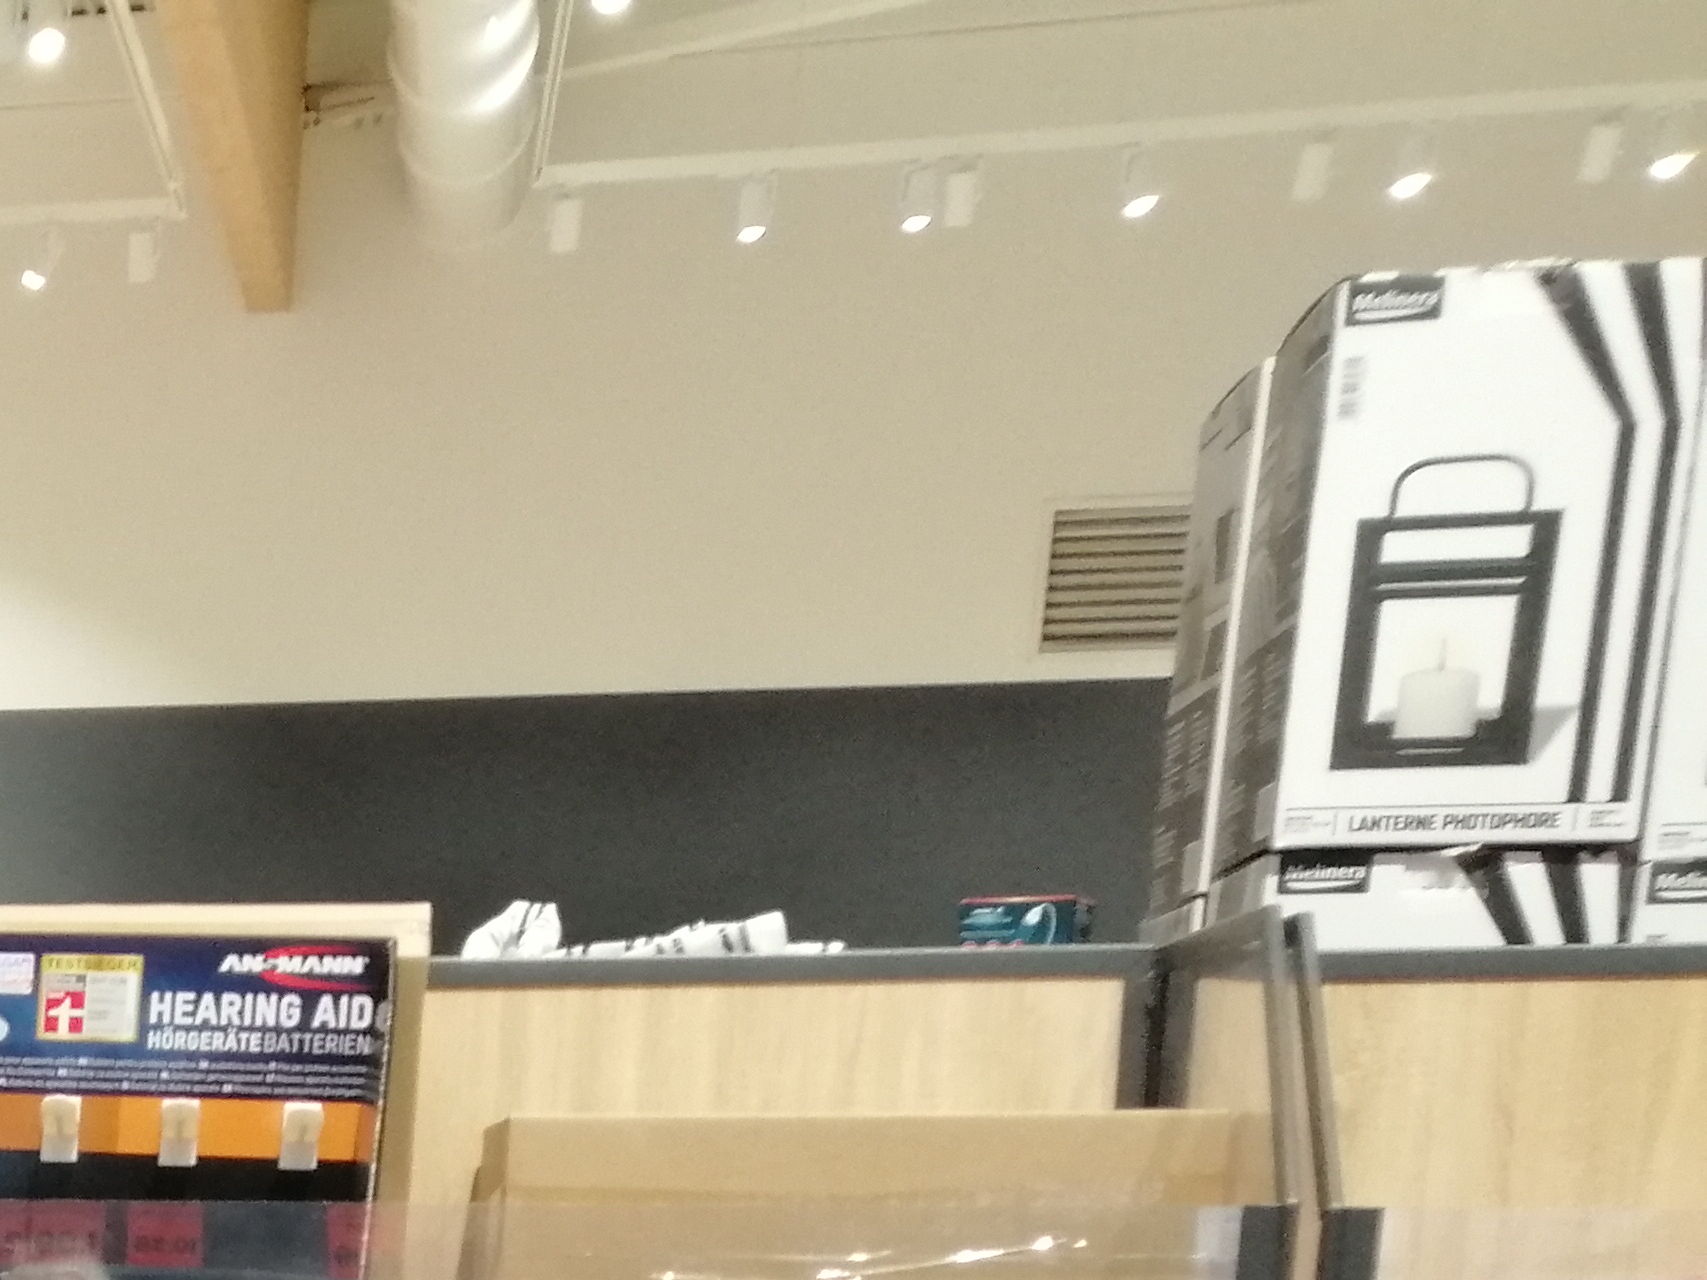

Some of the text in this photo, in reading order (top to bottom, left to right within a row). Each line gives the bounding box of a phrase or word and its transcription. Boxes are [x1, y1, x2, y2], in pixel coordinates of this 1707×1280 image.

[1348, 811, 1563, 832] LANTERNE PHOTOPHORE
[219, 953, 367, 975] ANSMANN
[148, 990, 375, 1030] HEARING AID
